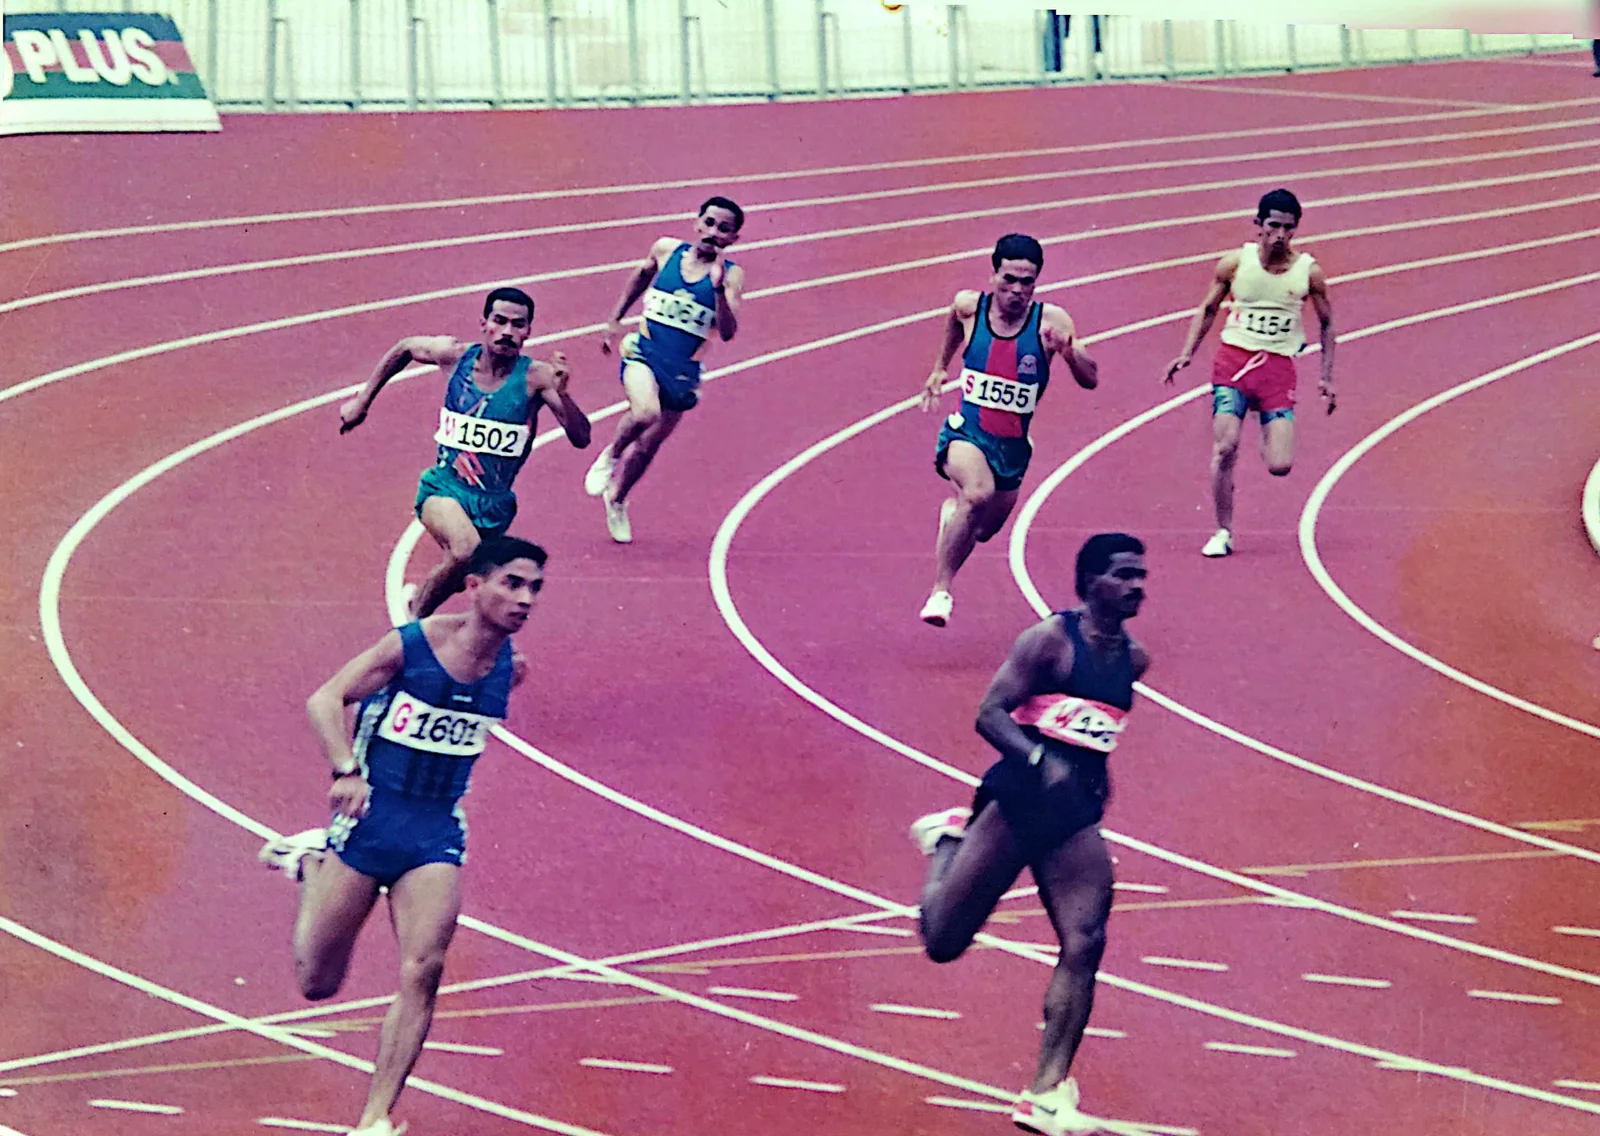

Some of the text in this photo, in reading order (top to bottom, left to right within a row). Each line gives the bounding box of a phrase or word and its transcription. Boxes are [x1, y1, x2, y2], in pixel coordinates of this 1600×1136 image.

[1246, 313, 1292, 336] 1154
[965, 374, 1031, 408] S 1555
[458, 422, 519, 453] 1502
[393, 703, 480, 746] G 1601
